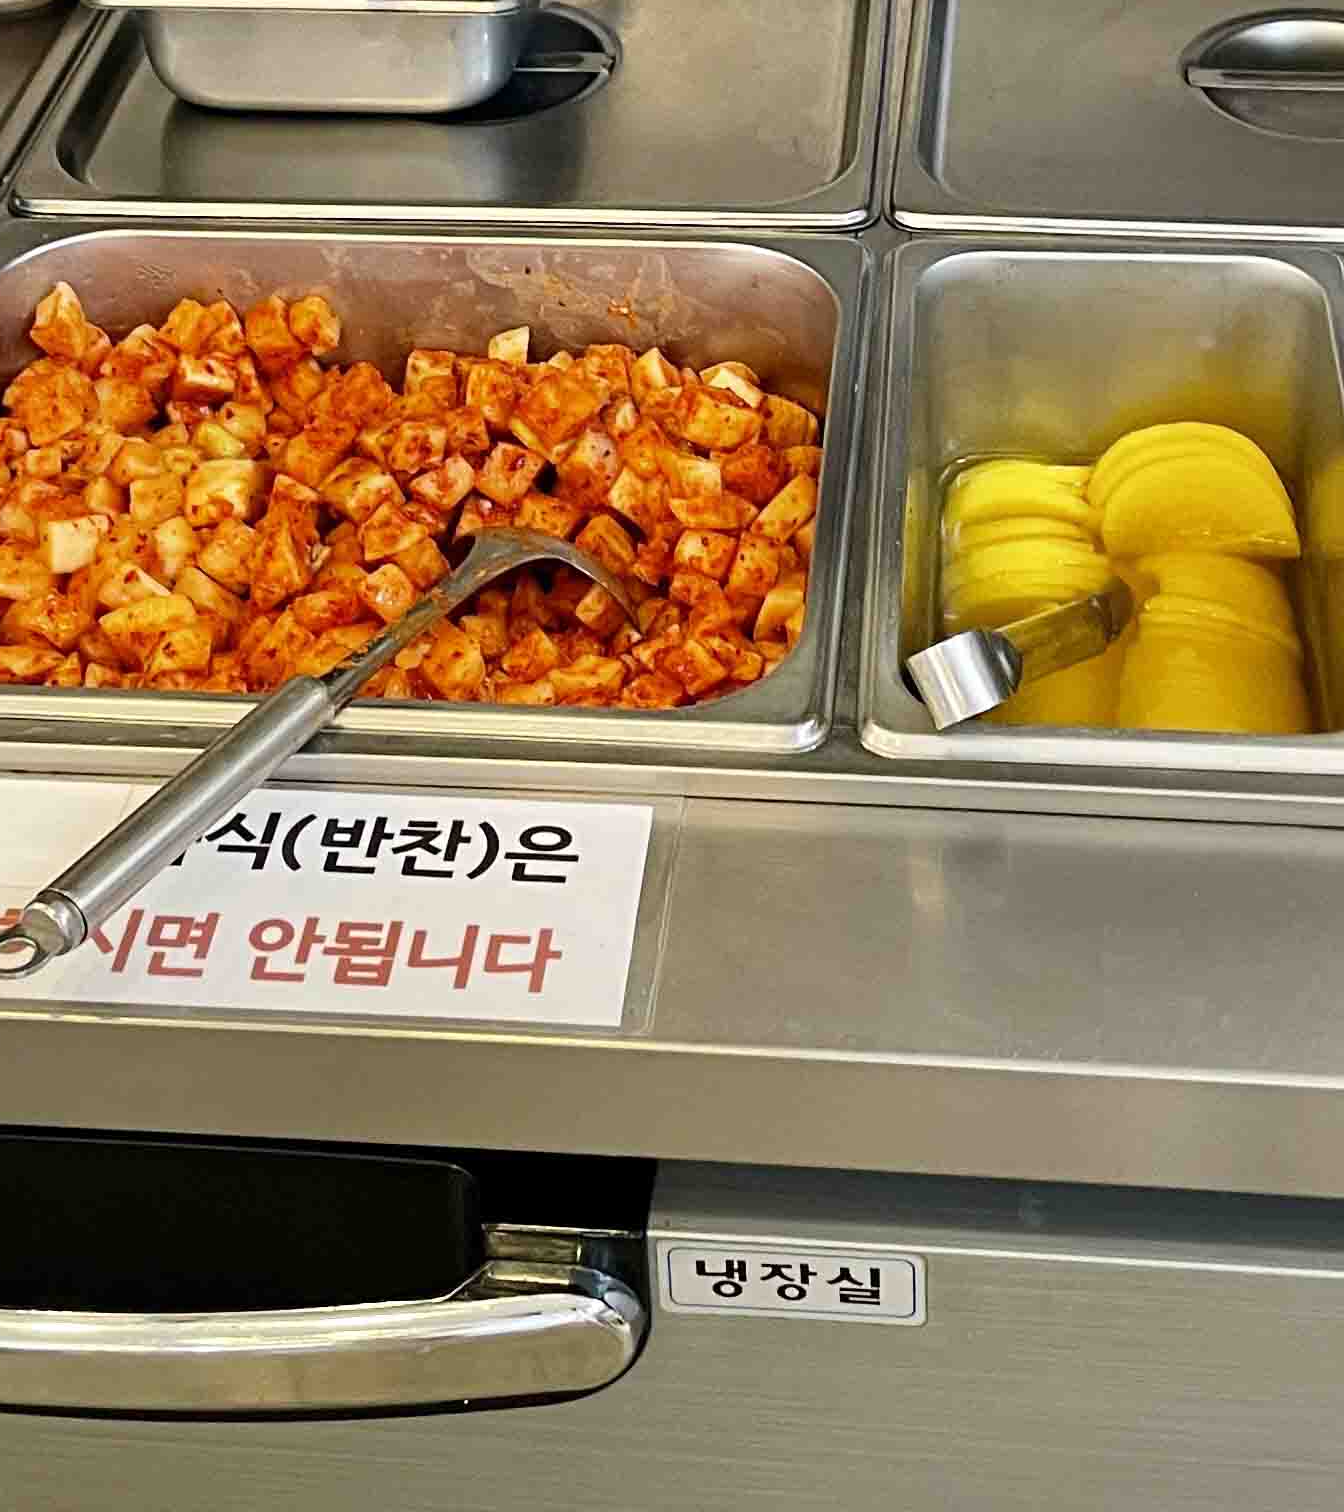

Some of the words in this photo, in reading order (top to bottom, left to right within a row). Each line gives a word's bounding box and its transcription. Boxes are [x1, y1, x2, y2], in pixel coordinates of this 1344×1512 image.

[170, 812, 579, 884] 식(반찬)은
[248, 916, 562, 994] 안됩니다
[695, 1259, 882, 1306] 냉장실
